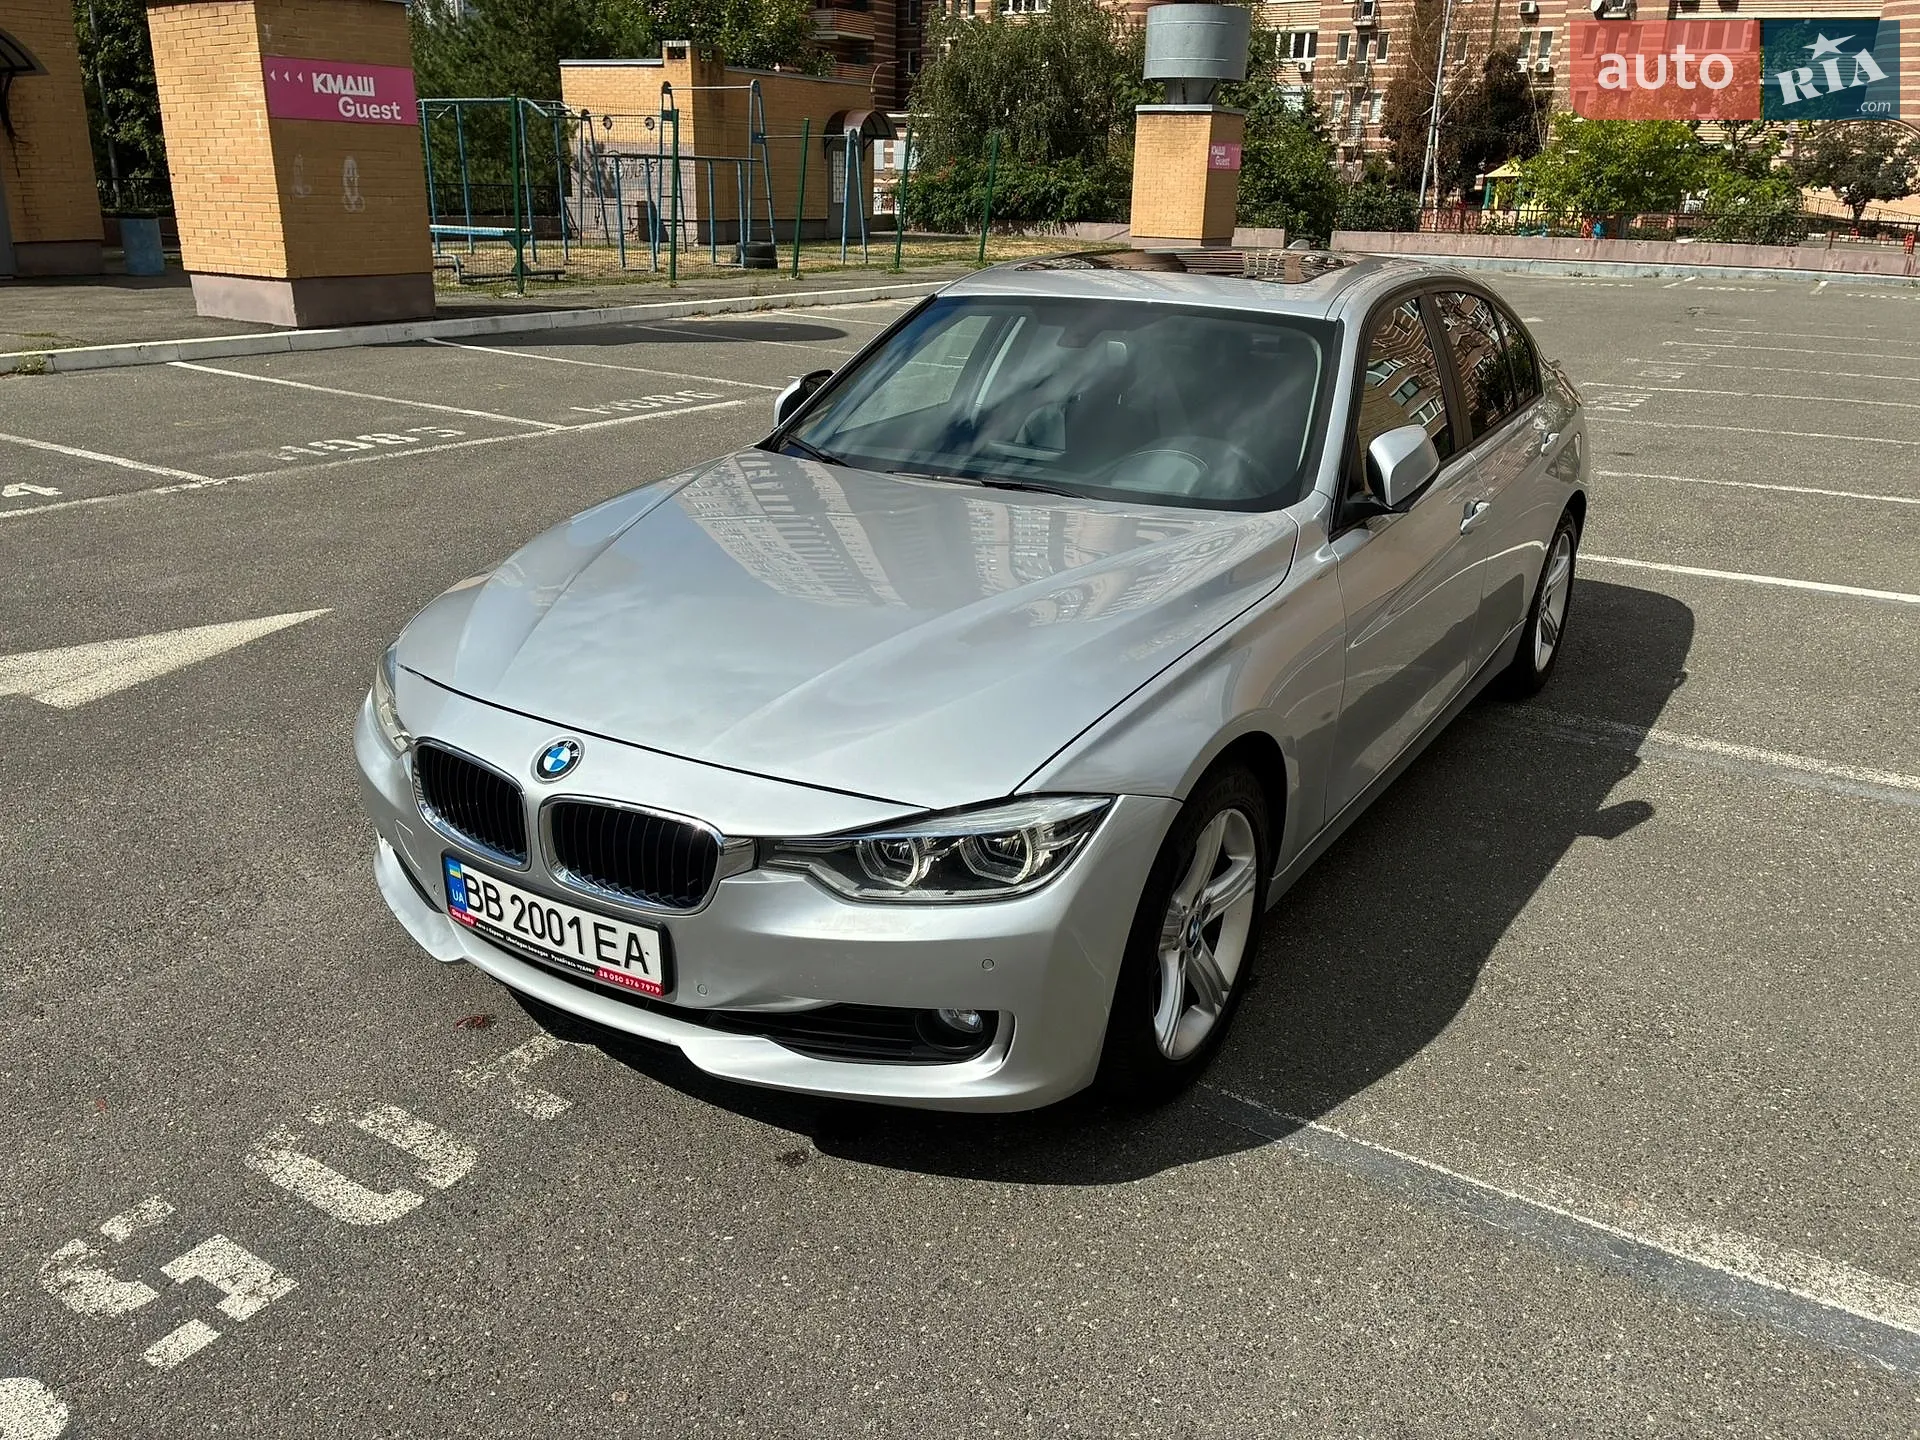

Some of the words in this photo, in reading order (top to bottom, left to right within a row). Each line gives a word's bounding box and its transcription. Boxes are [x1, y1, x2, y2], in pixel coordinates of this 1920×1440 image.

[337, 96, 402, 120] Guest
[452, 888, 465, 902] UA
[463, 873, 504, 921] BB
[510, 894, 585, 956] 2001
[593, 921, 649, 974] EA
